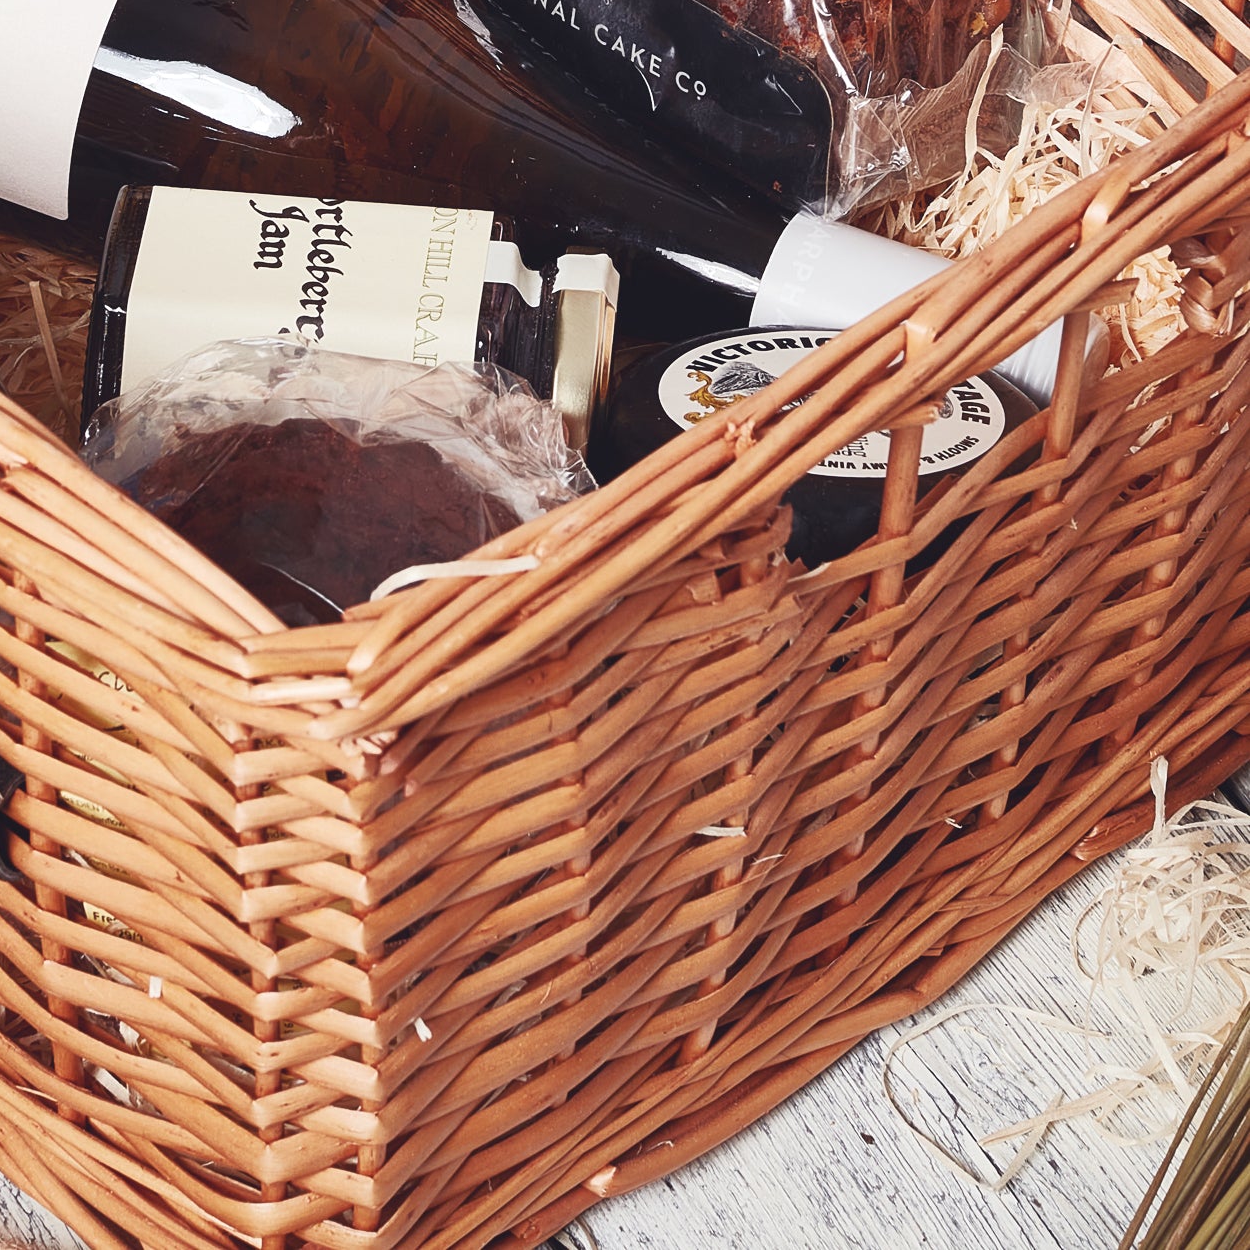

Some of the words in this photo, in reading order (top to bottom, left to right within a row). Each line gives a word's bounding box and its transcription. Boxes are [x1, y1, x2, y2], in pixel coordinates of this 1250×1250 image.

[594, 23, 661, 78] CAKE
[249, 199, 310, 270] Jam
[422, 238, 454, 289] HILL
[934, 435, 980, 461] SMOOTH
